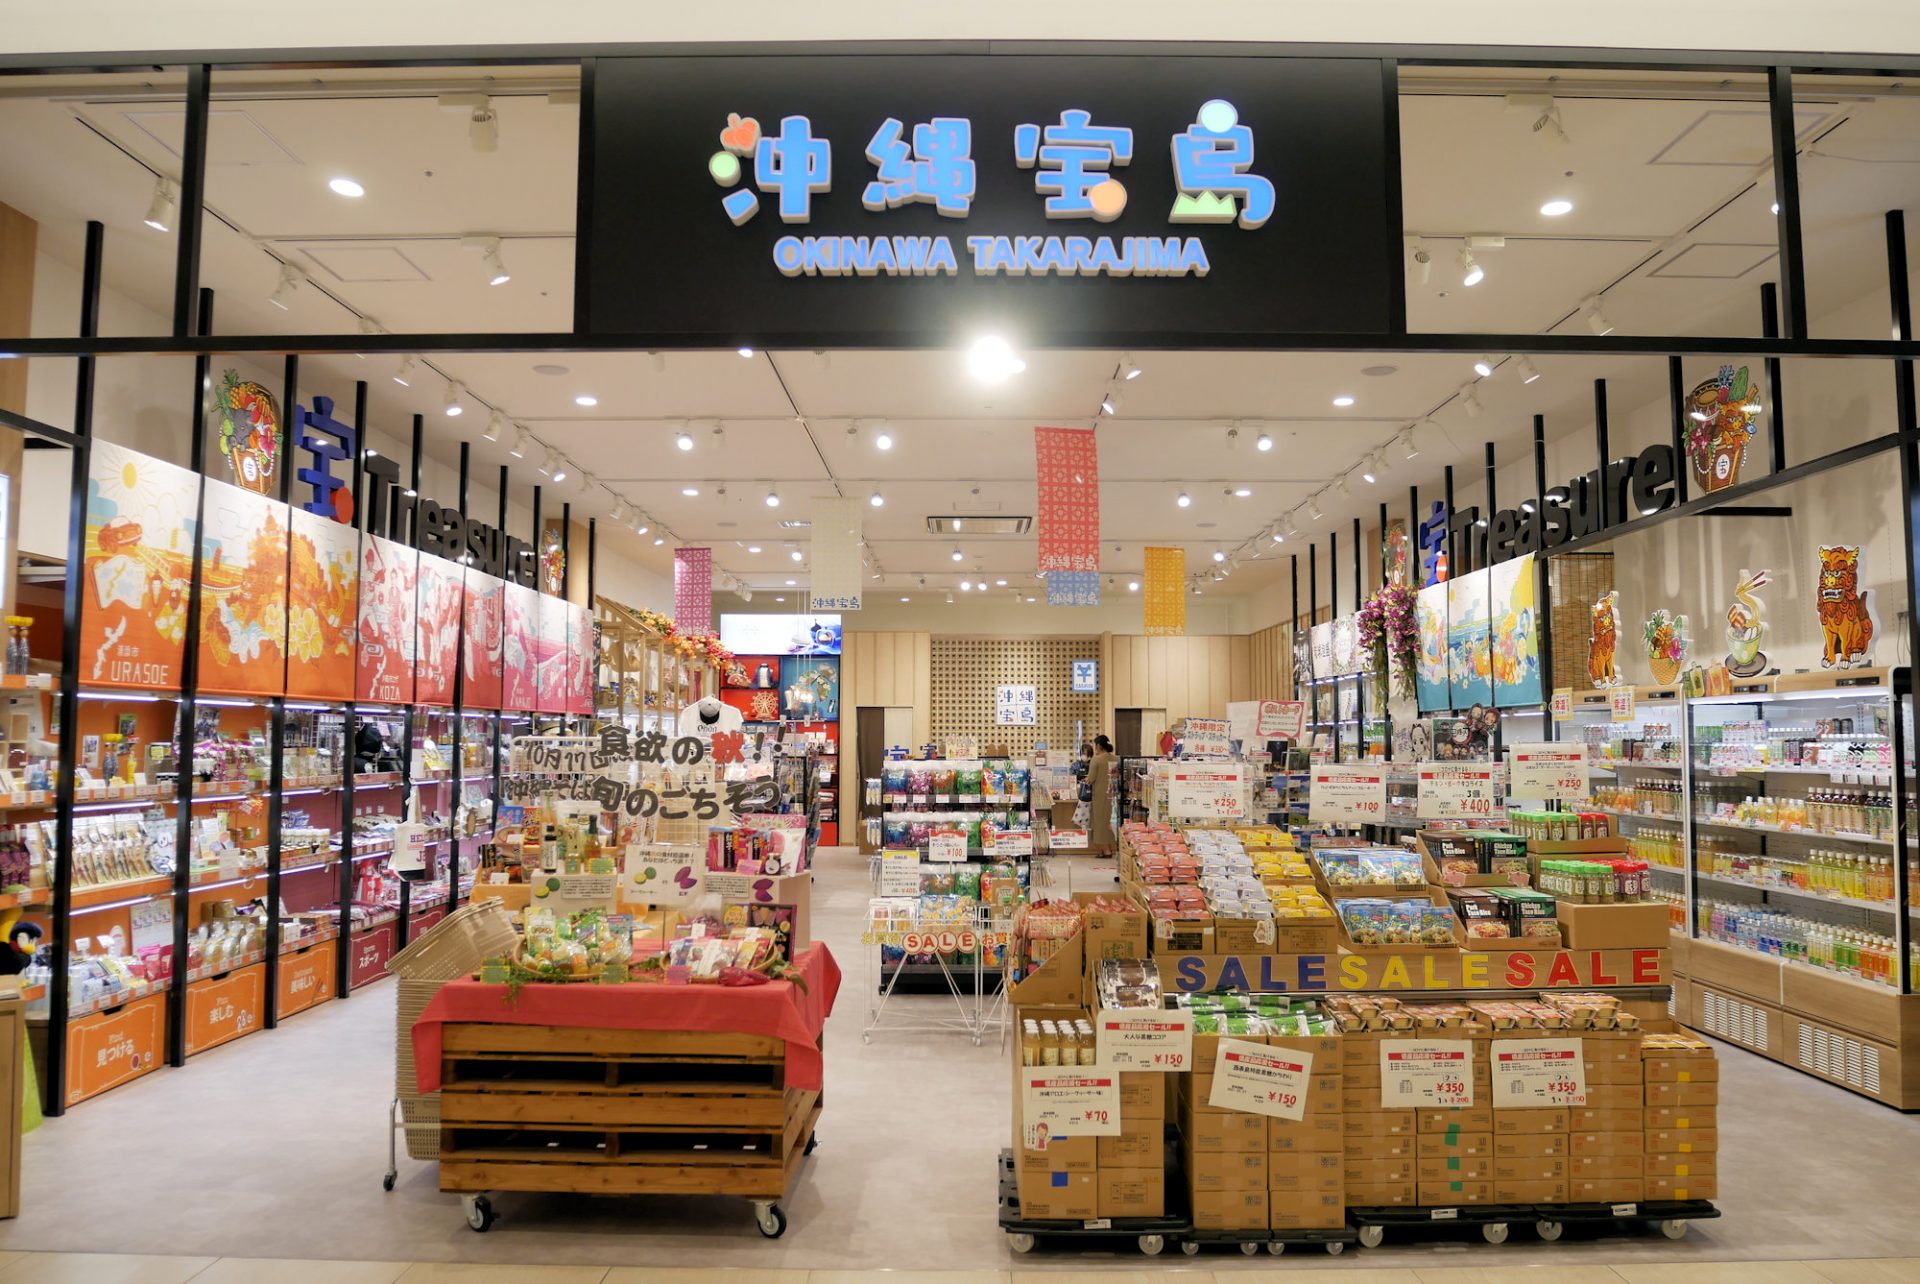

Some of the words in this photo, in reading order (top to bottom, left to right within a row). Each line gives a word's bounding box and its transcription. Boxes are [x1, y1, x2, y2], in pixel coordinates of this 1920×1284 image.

[709, 99, 1276, 229] 沖縄宝島
[773, 235, 958, 277] OKINAWA
[967, 235, 1210, 277] TAKARAJIMA
[1450, 444, 1675, 576] Treasure
[364, 449, 538, 591] Treasure
[111, 661, 168, 685] URASOE
[379, 686, 400, 700] KOZA
[1558, 779, 1581, 788] ¥250
[591, 775, 782, 819] 旬のごちそう
[1214, 798, 1237, 807] ¥250
[1355, 802, 1379, 811] ¥100
[1460, 799, 1490, 813] ¥400
[907, 932, 973, 949] SALE
[1176, 955, 1326, 992] SALE
[1339, 953, 1491, 989] SALE
[1505, 950, 1662, 988] SALE
[96, 1039, 134, 1068] 見つける
[1154, 1053, 1183, 1065] ¥150
[1436, 1082, 1465, 1093] ¥350
[1548, 1081, 1577, 1093] ¥350
[1268, 1091, 1297, 1105] ¥150
[1085, 1110, 1108, 1121] ¥70
